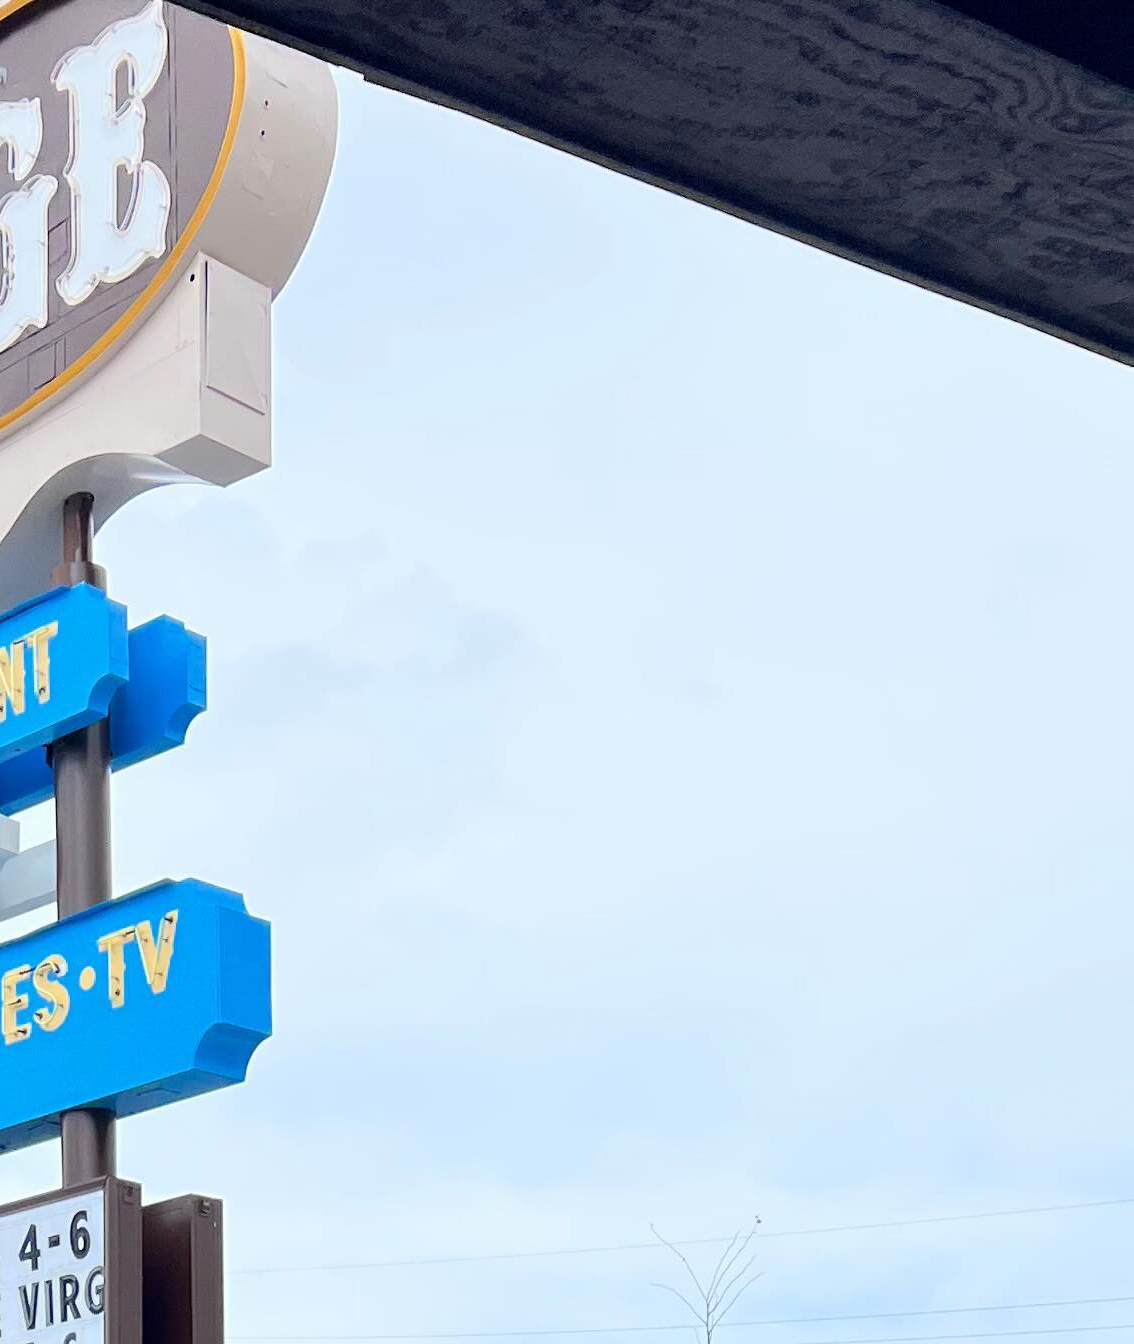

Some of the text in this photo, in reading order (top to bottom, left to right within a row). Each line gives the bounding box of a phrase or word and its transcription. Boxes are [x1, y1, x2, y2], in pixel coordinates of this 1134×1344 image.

[98, 910, 179, 1009] TV
[18, 1210, 90, 1271] 4-6
[18, 1265, 105, 1330] VIRG
